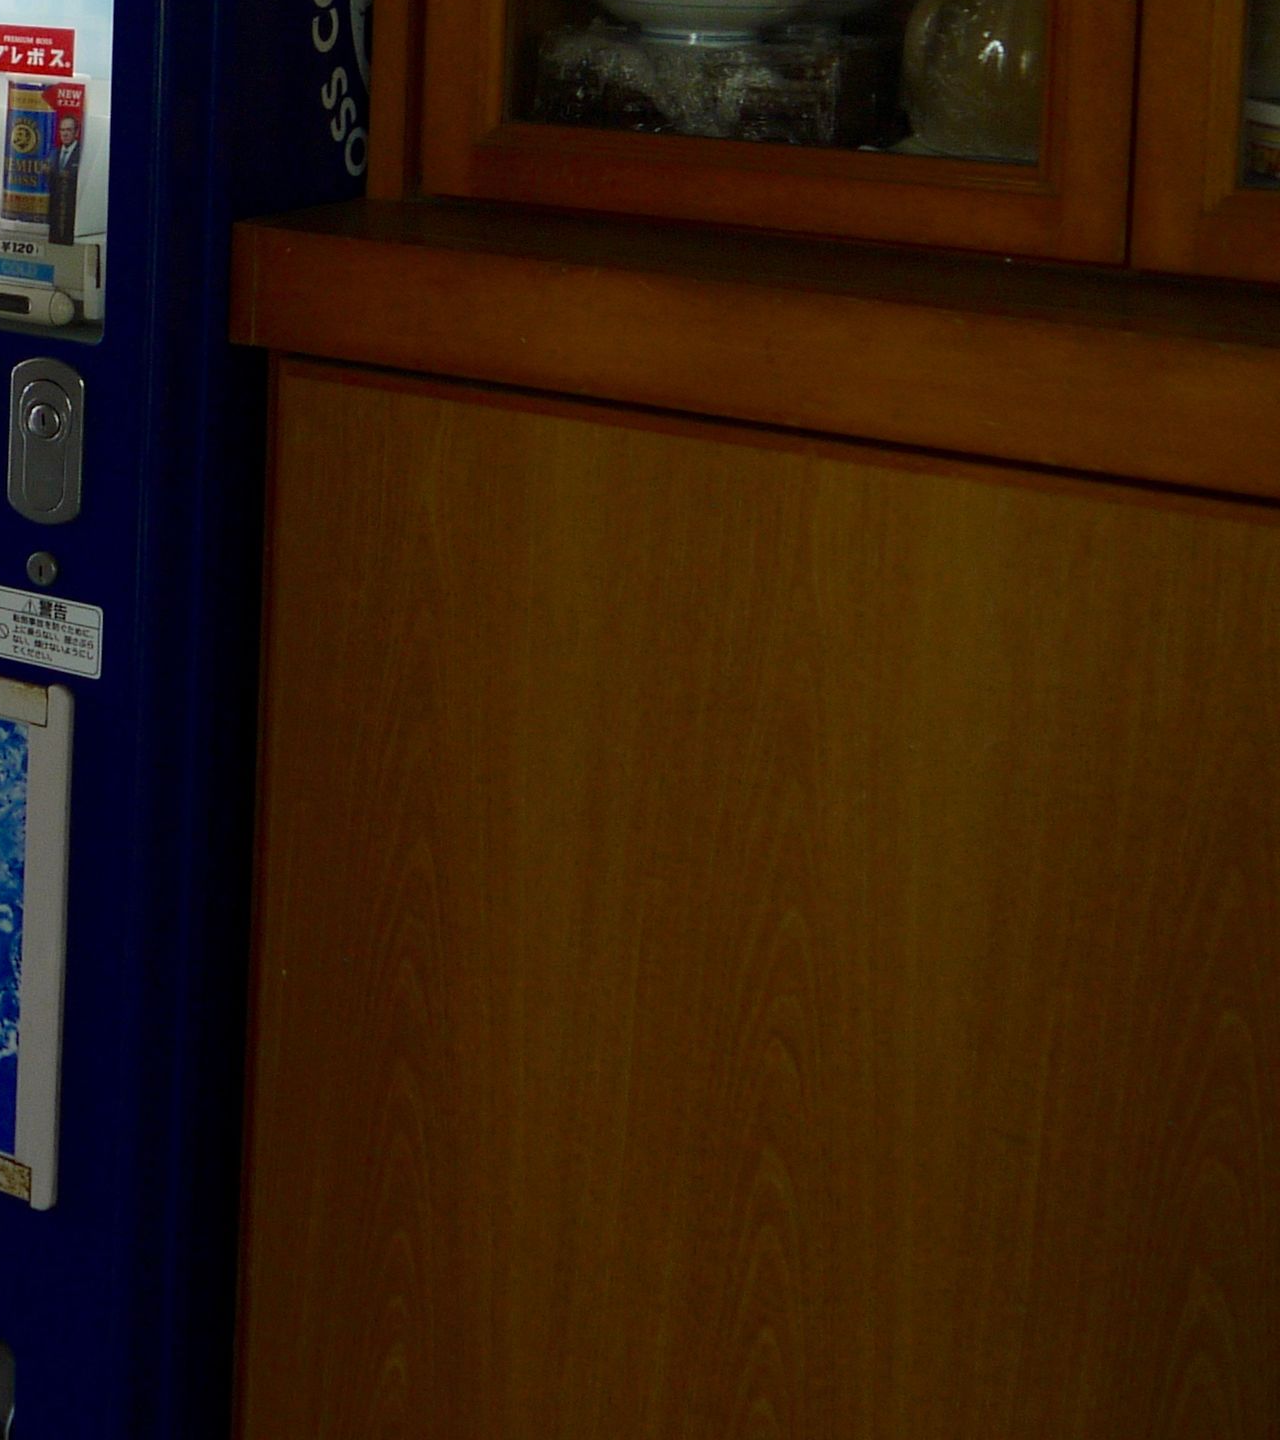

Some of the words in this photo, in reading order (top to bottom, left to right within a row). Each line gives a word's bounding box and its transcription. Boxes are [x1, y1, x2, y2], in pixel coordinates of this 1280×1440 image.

[3, 35, 34, 44] PREMIUM
[57, 88, 83, 99] NEW
[1, 241, 34, 255] ¥120
[39, 599, 68, 622] 警告
